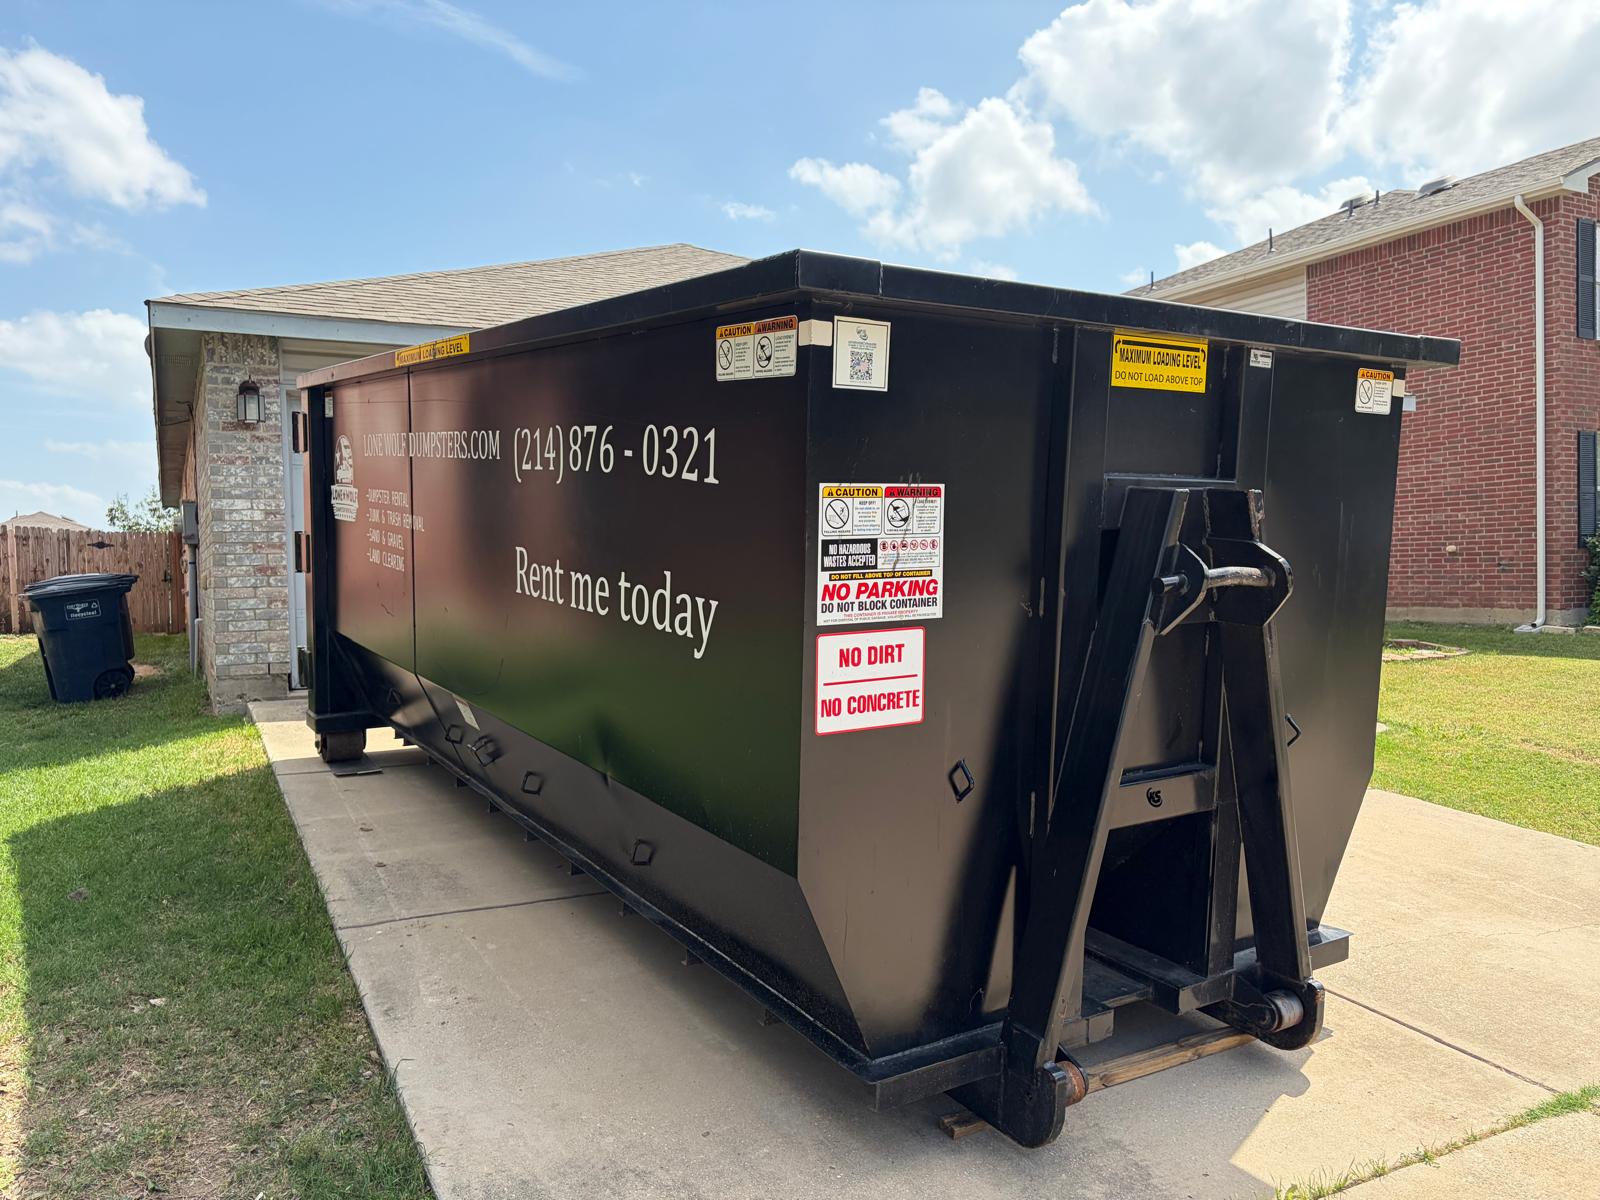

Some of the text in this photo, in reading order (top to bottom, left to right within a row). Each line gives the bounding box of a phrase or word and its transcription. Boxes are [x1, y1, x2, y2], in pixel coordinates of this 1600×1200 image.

[723, 319, 794, 337] CAUTION WARNING
[446, 342, 463, 354] LEVEL
[1120, 348, 1201, 369] MAXIMUM LOADING LEVEL
[1115, 370, 1203, 386] DO NOT LOAD ABOVE TOP
[1365, 371, 1391, 380] CAUTION
[642, 424, 720, 485] 0321
[835, 488, 938, 497] CAUTION WARNING
[829, 543, 871, 555] NO HAZARDOUS
[824, 555, 847, 567] WASTES
[848, 554, 876, 567] ACCEPTED
[821, 579, 939, 601] NO PARKING
[515, 546, 719, 660] Rent me today
[821, 597, 938, 614] DO NOT BLOCK CONTAINER
[839, 643, 905, 668] NO DIRT
[821, 689, 920, 718] NO CONCRETE
